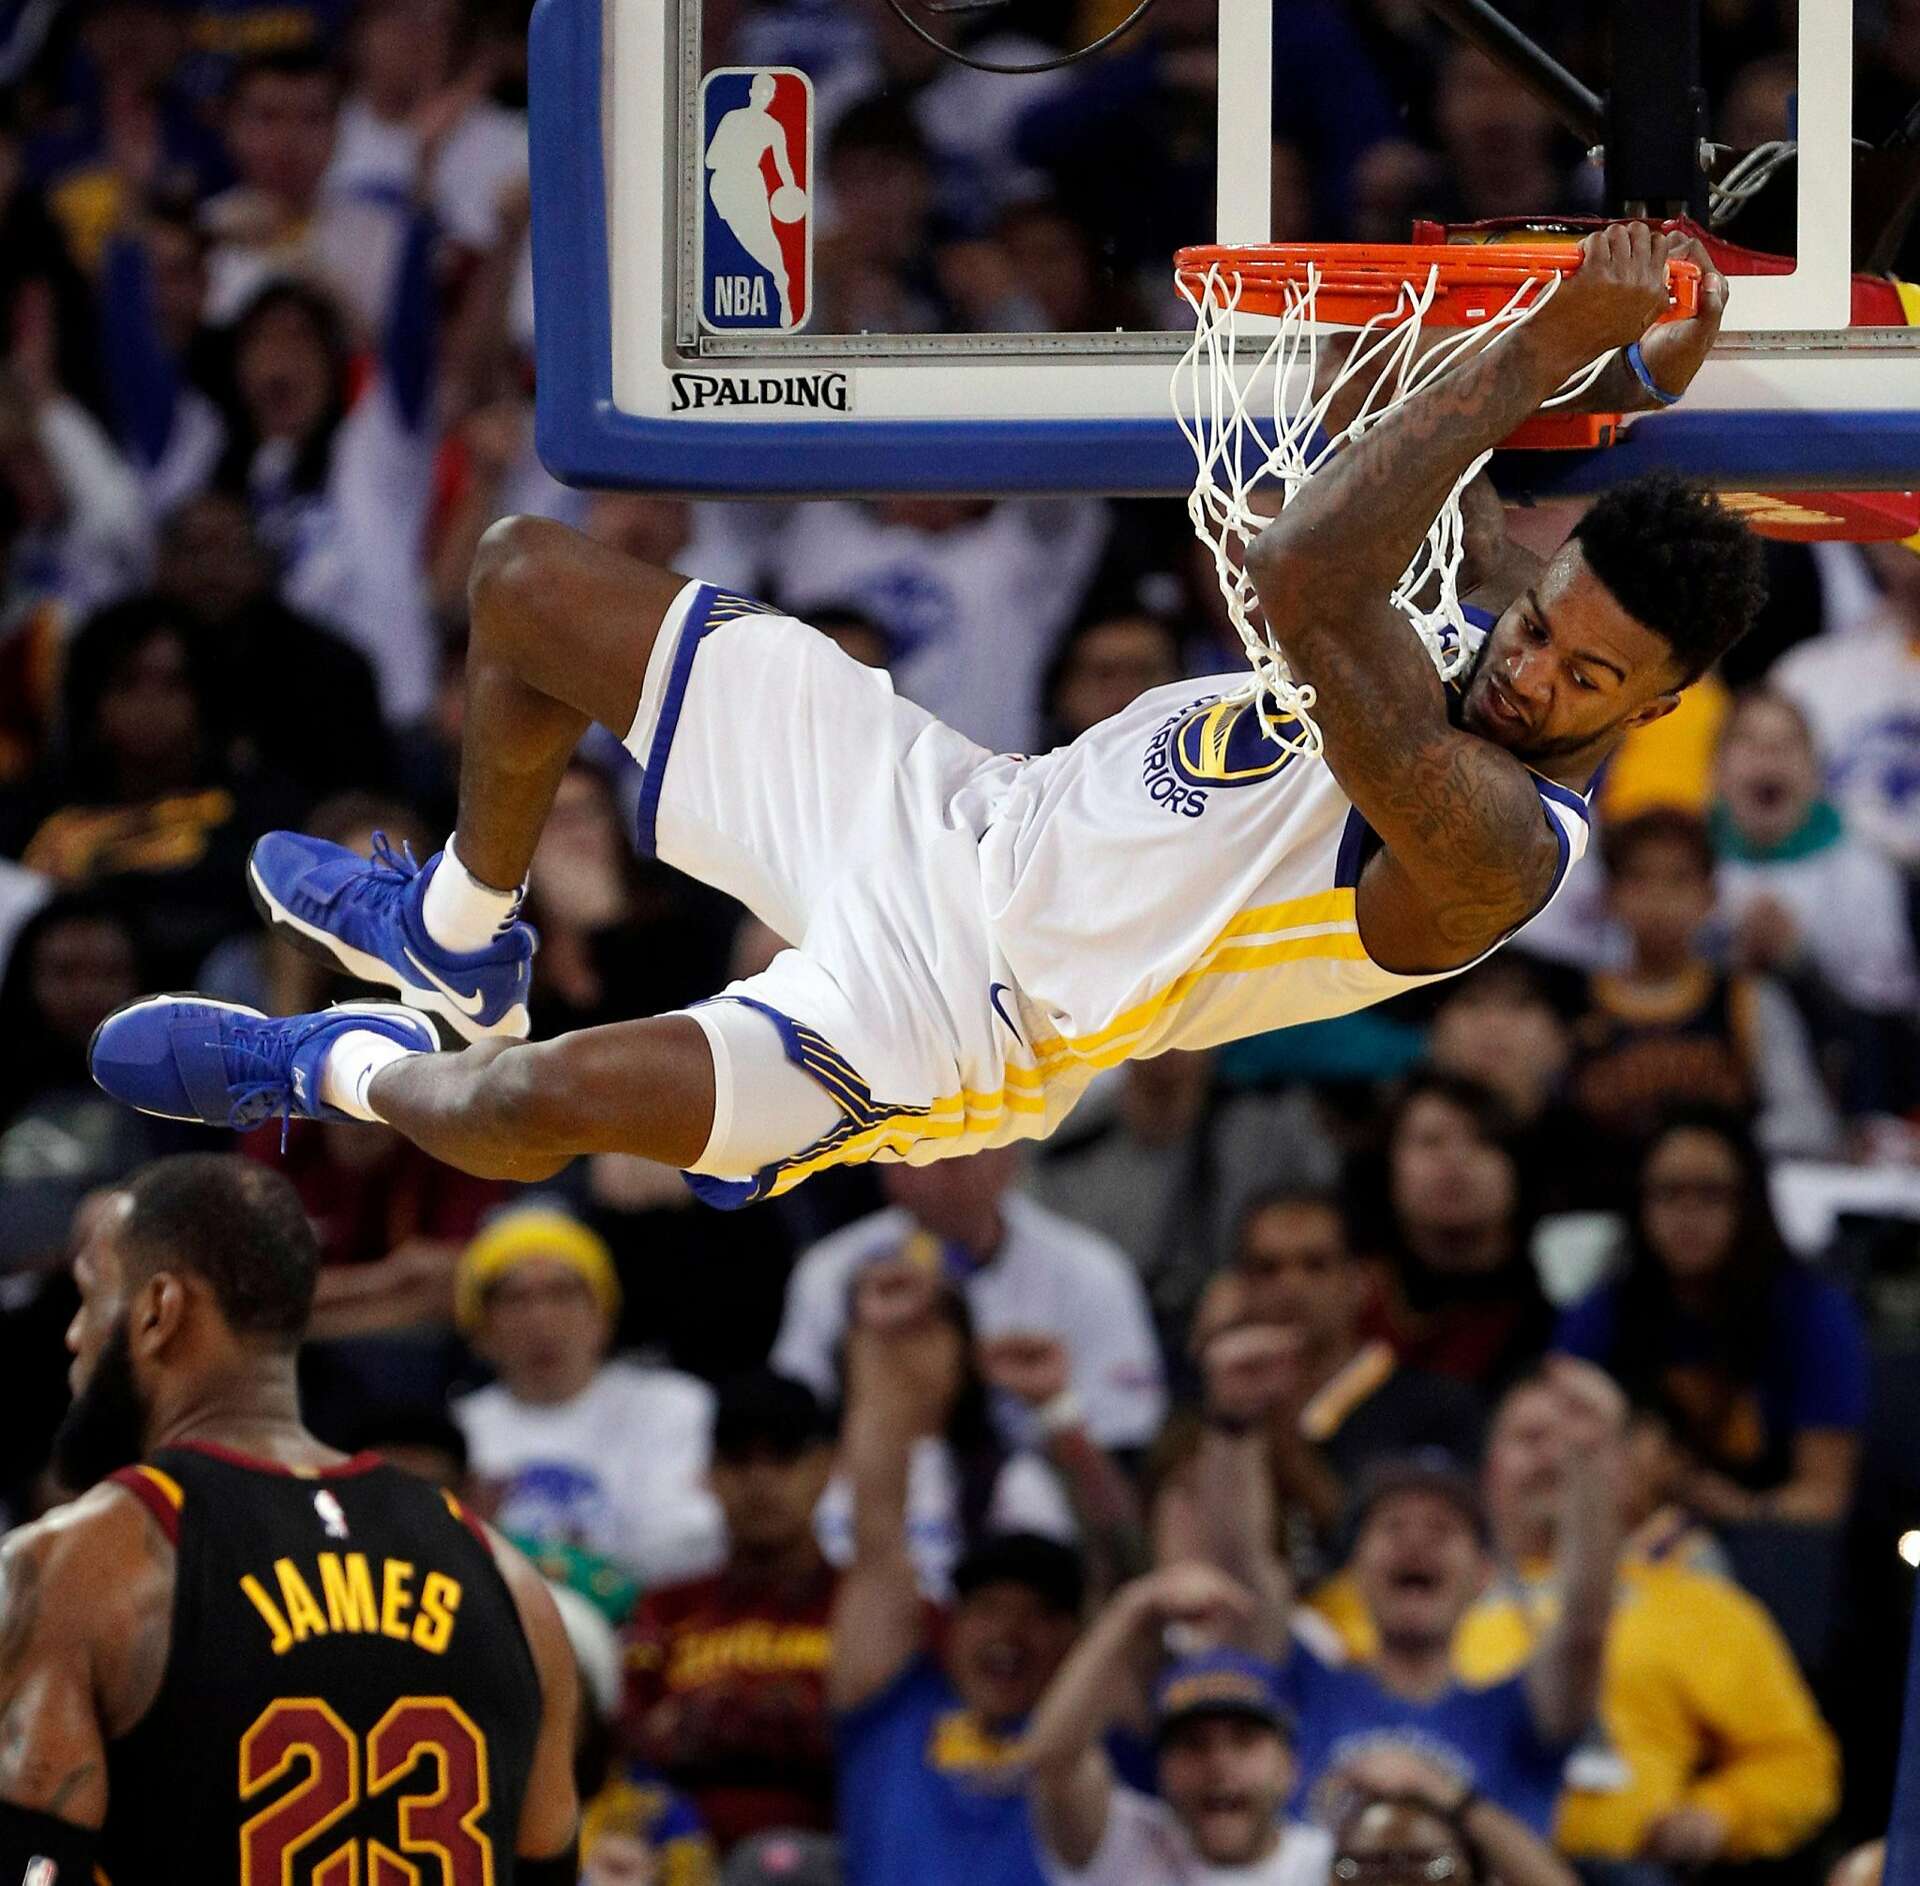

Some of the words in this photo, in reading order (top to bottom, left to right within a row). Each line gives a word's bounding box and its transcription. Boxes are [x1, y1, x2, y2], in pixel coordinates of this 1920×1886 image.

[714, 275, 768, 317] NBA
[671, 373, 847, 411] SPALDING
[239, 1552, 462, 1655] JAMES
[239, 1696, 496, 1886] 23
